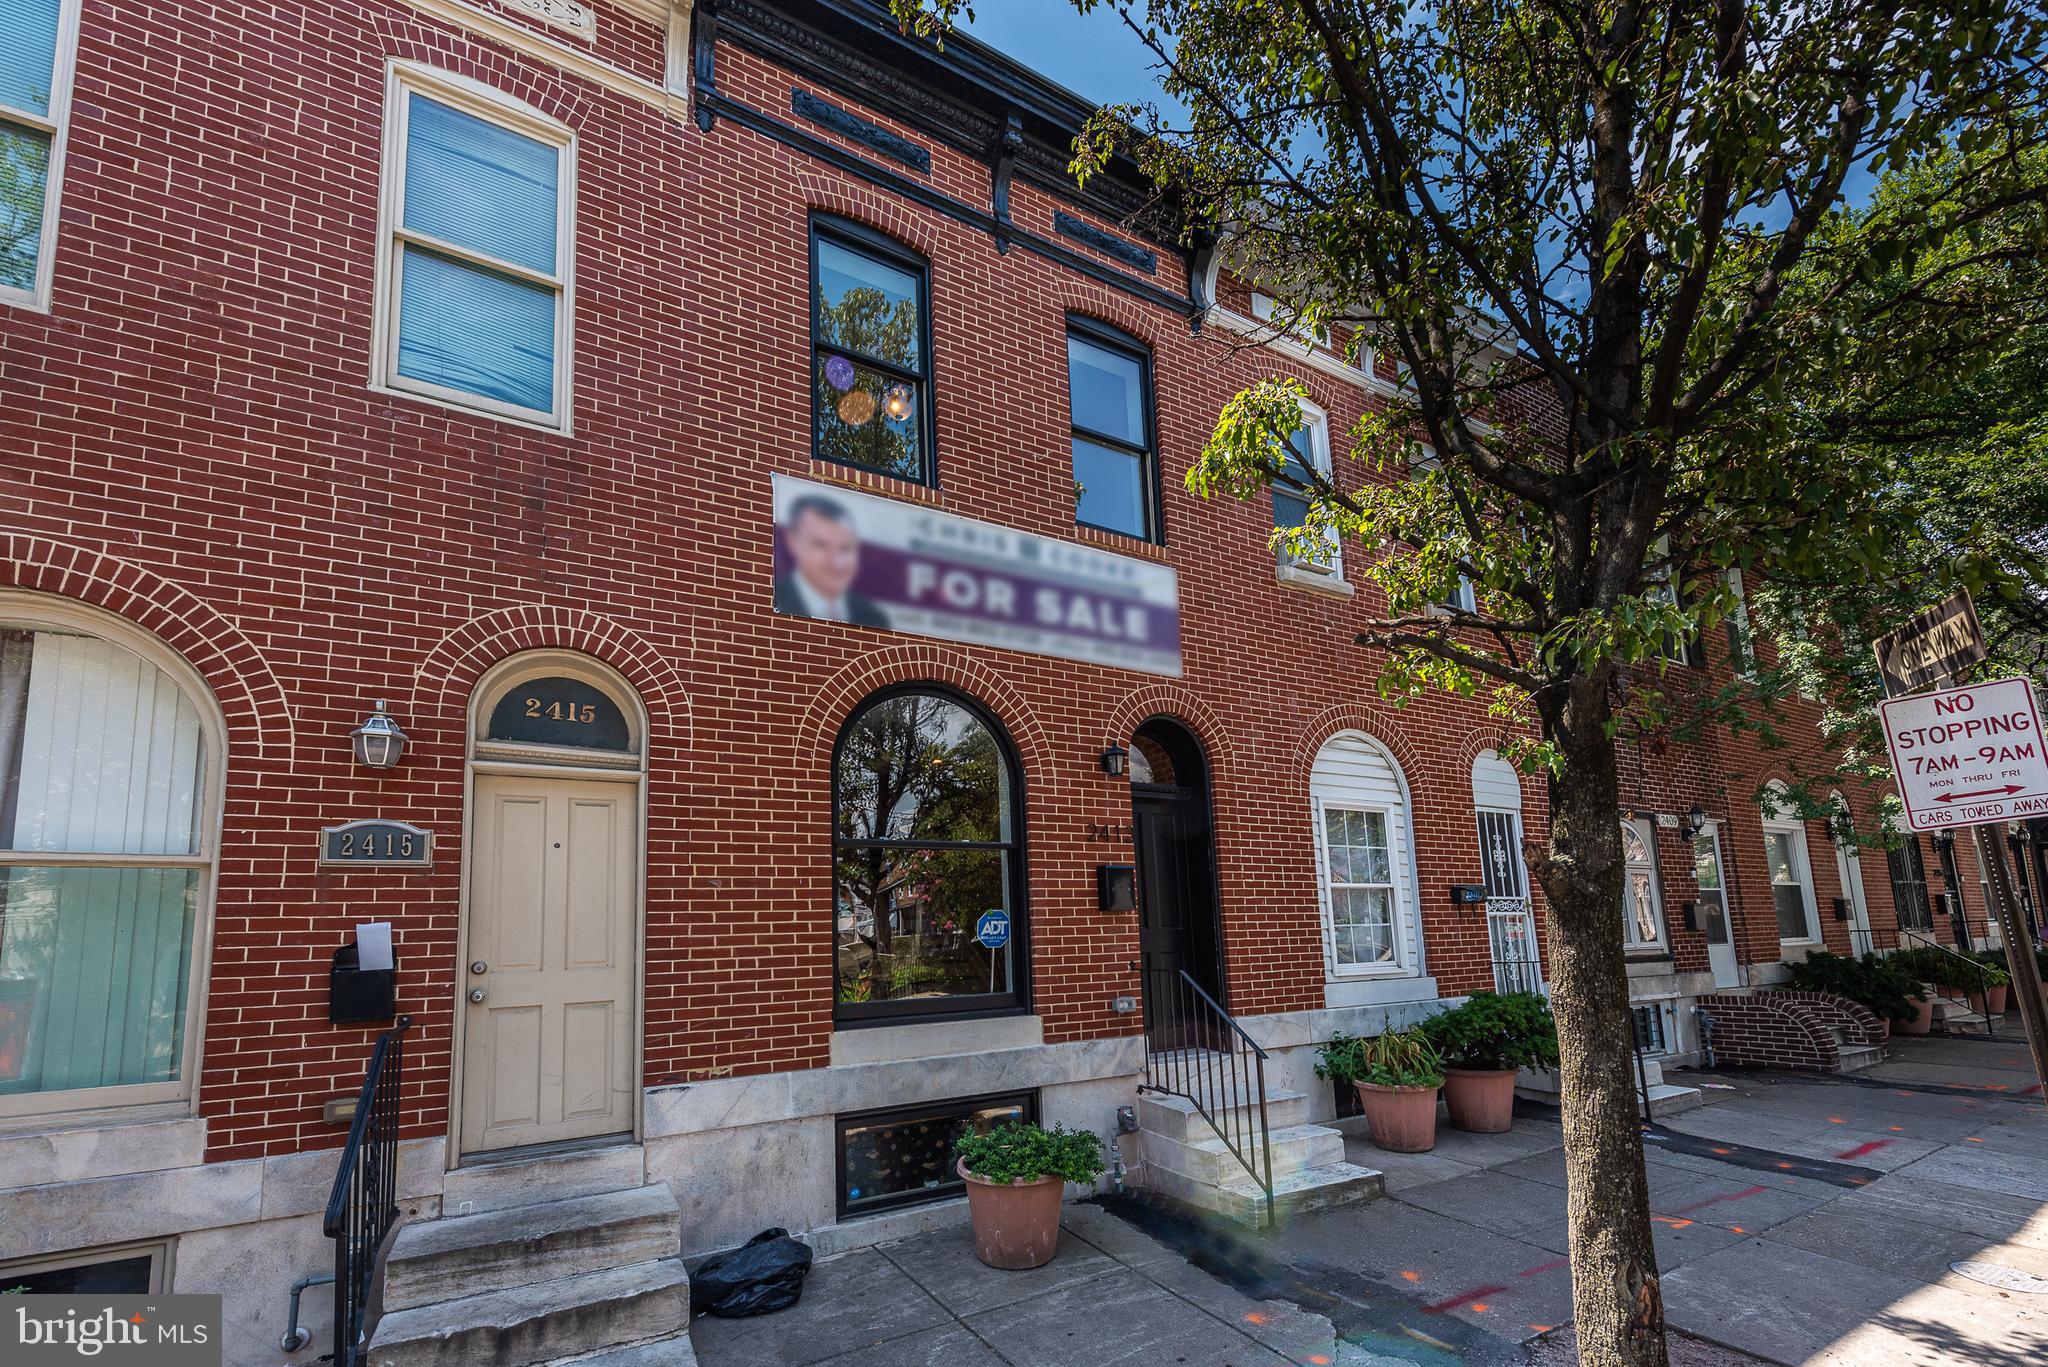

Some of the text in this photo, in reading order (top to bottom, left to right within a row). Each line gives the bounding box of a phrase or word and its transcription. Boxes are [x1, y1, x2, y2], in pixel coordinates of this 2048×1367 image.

[906, 561, 1016, 616] FOR
[1033, 588, 1150, 641] SALE
[1902, 617, 1970, 670] ONE WAY
[525, 698, 596, 724] 2415
[1934, 693, 1974, 716] NO
[1898, 712, 2030, 750] STOPPING
[1929, 769, 2021, 789] MON THRU FRI
[1660, 815, 1677, 826] 2409
[1919, 798, 2048, 825] CARS TOWED AWAY
[341, 833, 412, 857] 2415
[1088, 824, 1134, 843] 2413
[981, 920, 1008, 935] ADT
